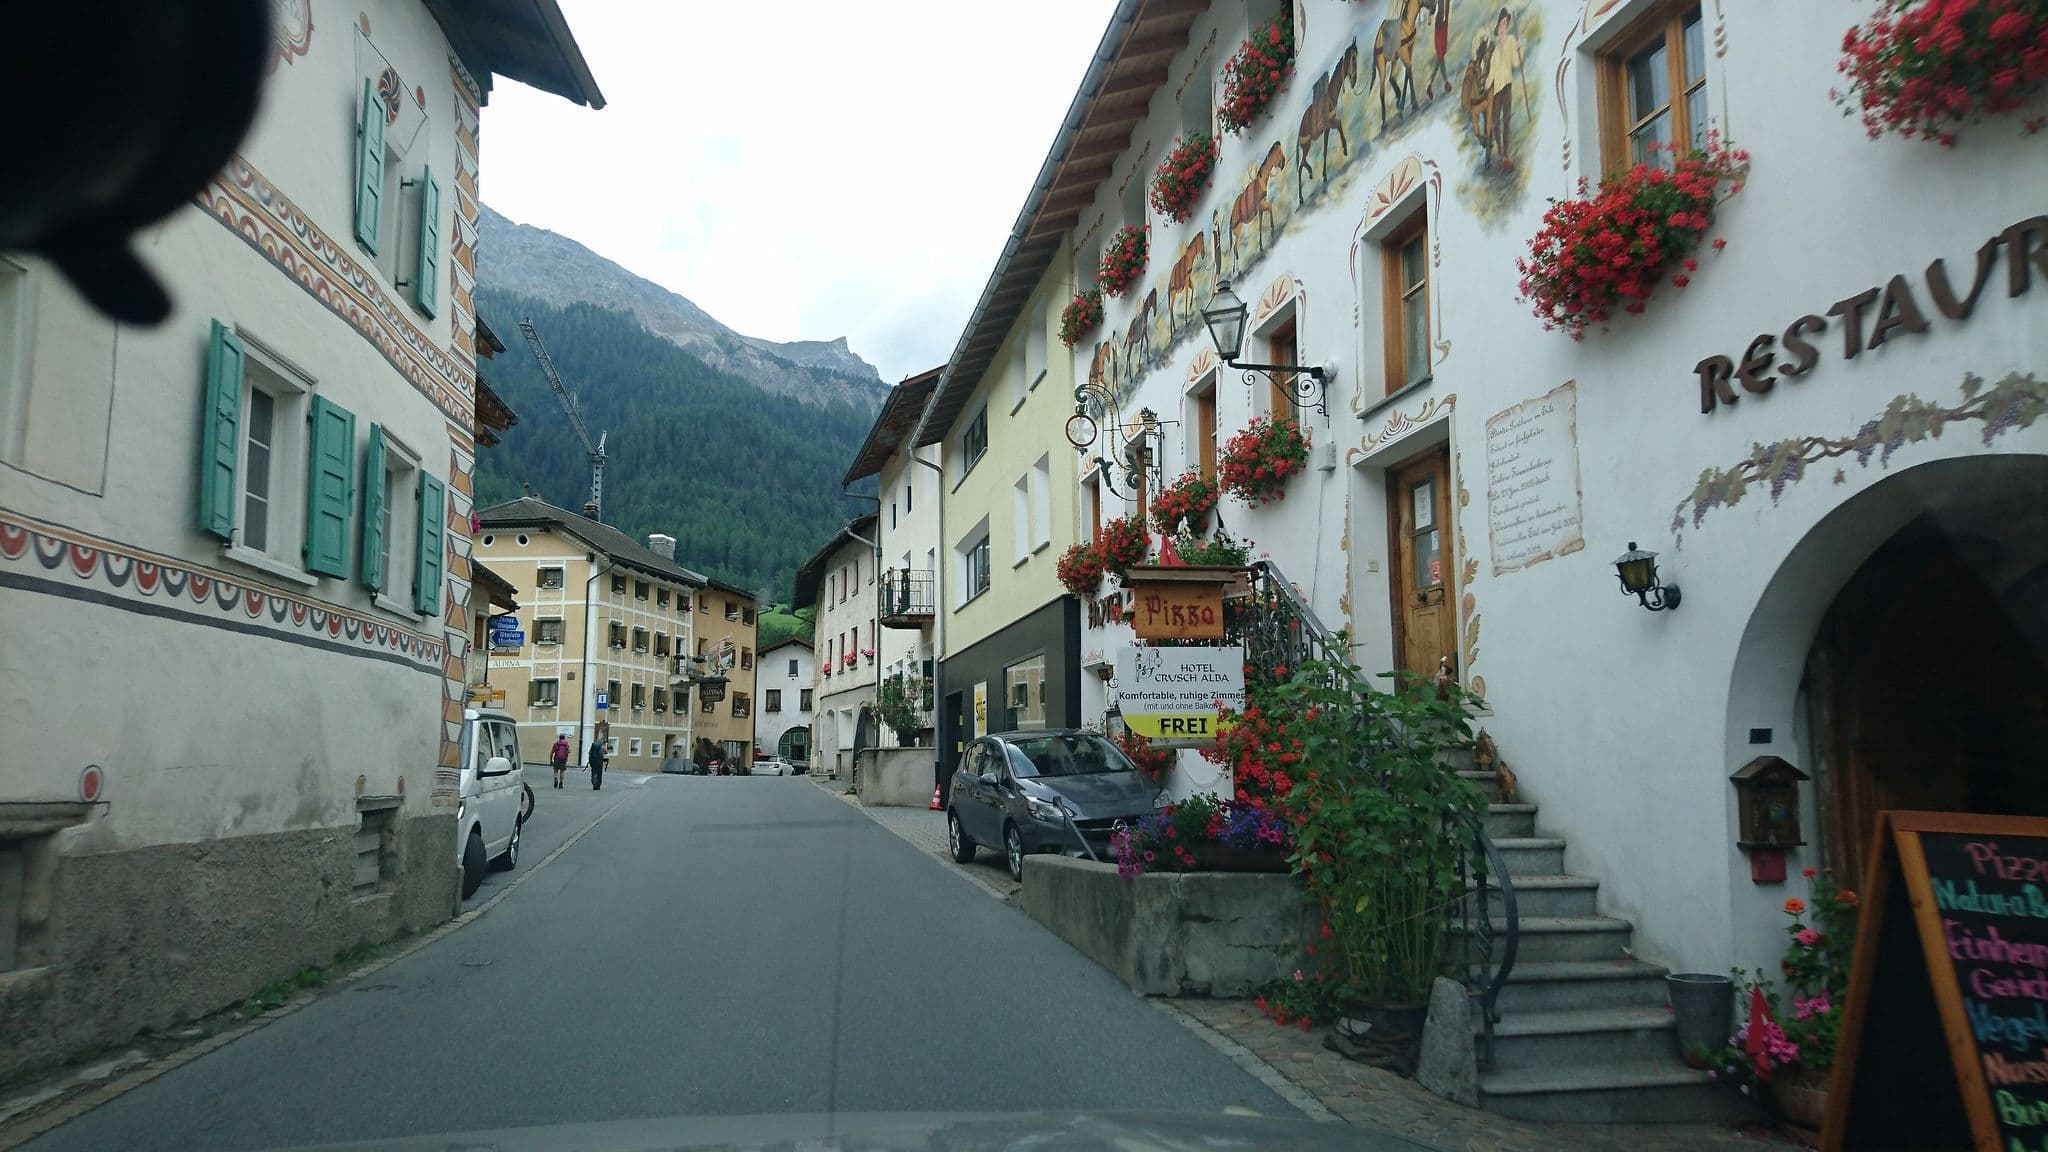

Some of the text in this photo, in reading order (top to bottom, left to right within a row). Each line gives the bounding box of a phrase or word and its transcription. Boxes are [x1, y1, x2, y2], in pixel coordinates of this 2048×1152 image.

[1145, 595, 1215, 627] Pizza
[1181, 663, 1215, 672] HOTEL
[1201, 674, 1230, 682] ALBA
[1119, 691, 1177, 701] Komfortable,
[1180, 691, 1208, 701] ruhige
[1144, 702, 1158, 711] (mit
[1160, 702, 1174, 710] und
[1176, 702, 1193, 710] ohne
[1160, 718, 1208, 734] FREI
